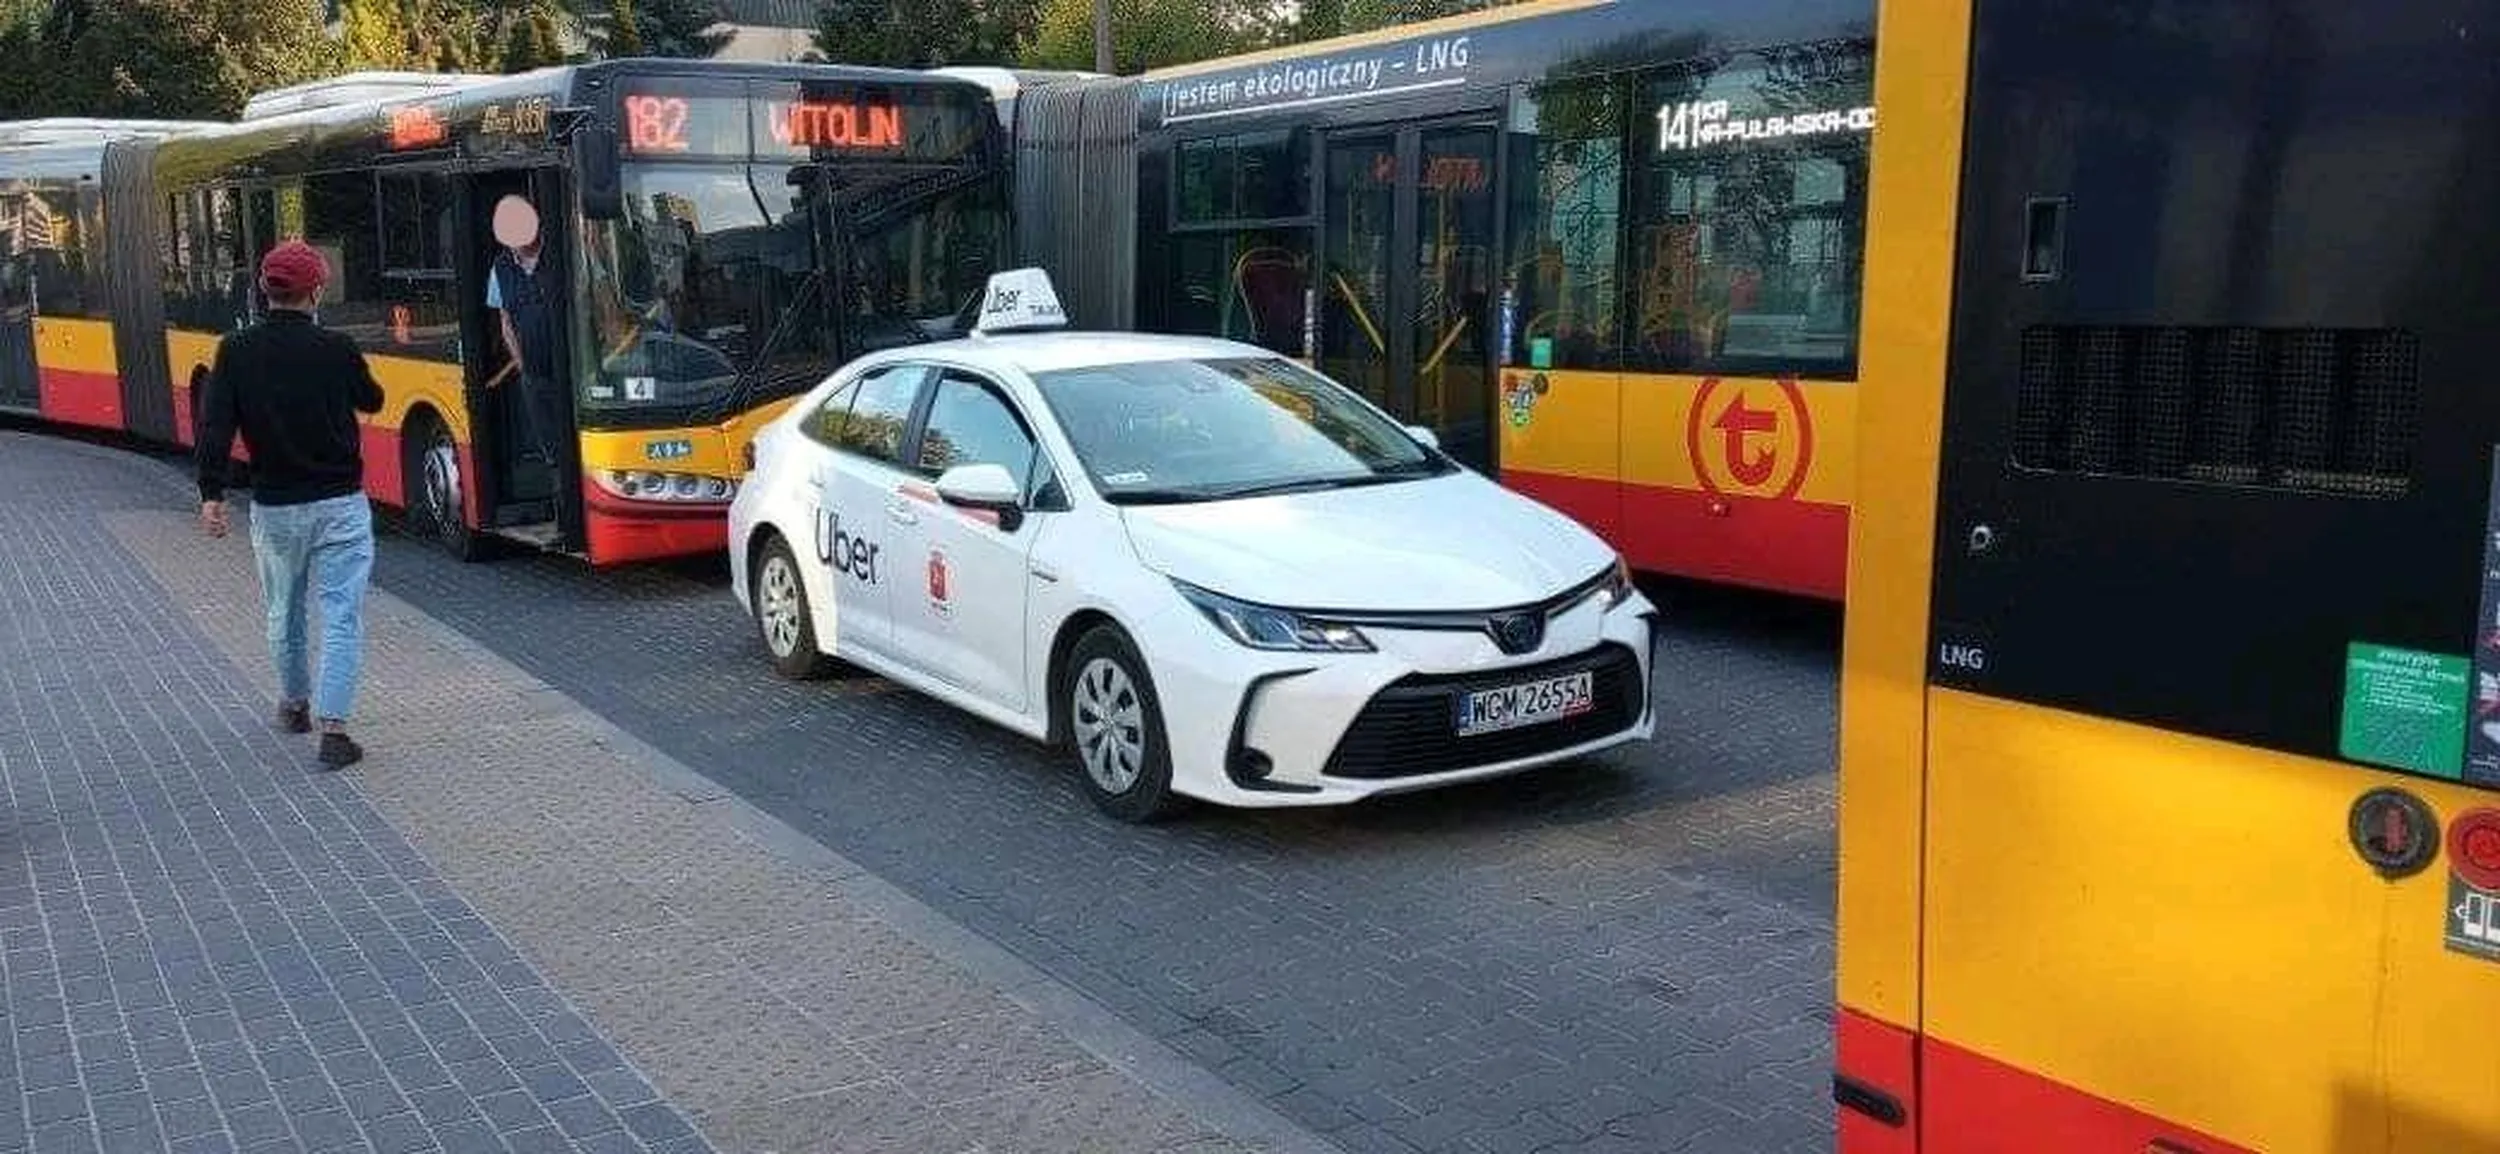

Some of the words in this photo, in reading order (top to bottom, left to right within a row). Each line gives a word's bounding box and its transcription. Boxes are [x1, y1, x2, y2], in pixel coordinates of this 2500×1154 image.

[1244, 56, 1383, 98] ekologiczny
[1416, 37, 1470, 74] LNG
[626, 96, 691, 149] 182
[767, 102, 901, 146] WITOLIN
[1656, 100, 1700, 151] 141
[986, 284, 1021, 313] Uber
[634, 379, 646, 397] 4
[815, 507, 880, 585] Uber
[1941, 643, 1984, 670] LNG
[1524, 674, 1591, 715] 2655A
